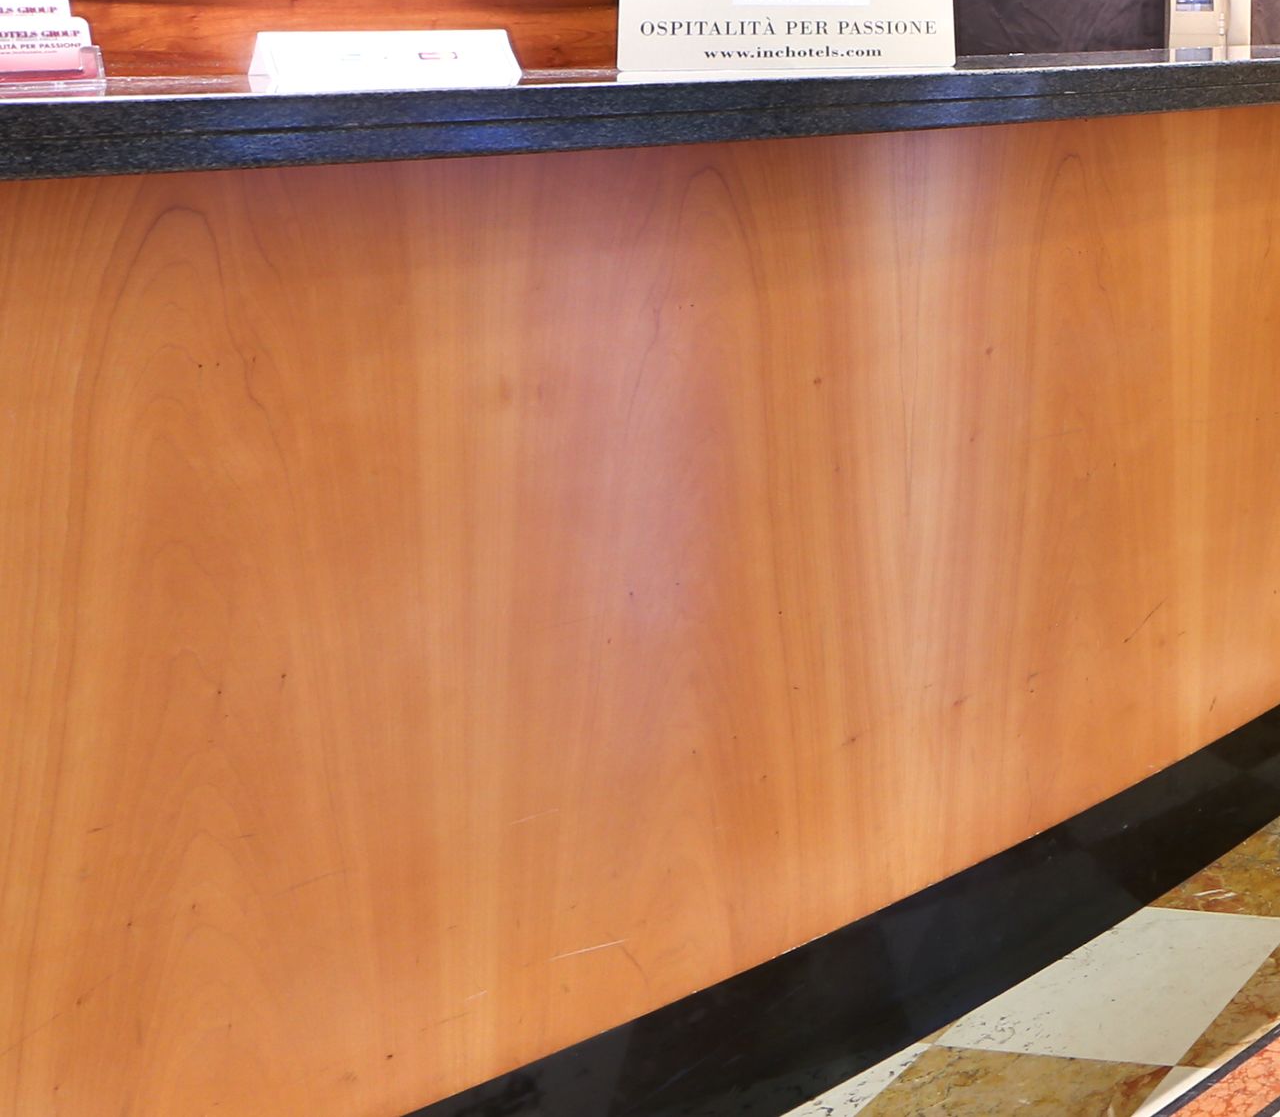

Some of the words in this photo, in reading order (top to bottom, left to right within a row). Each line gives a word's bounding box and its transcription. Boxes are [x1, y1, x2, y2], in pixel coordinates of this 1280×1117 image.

[640, 17, 776, 36] OSPITALITÀ
[785, 21, 828, 35] PER
[838, 21, 937, 35] PASSIONE
[704, 45, 882, 58] www.inchotels.com
